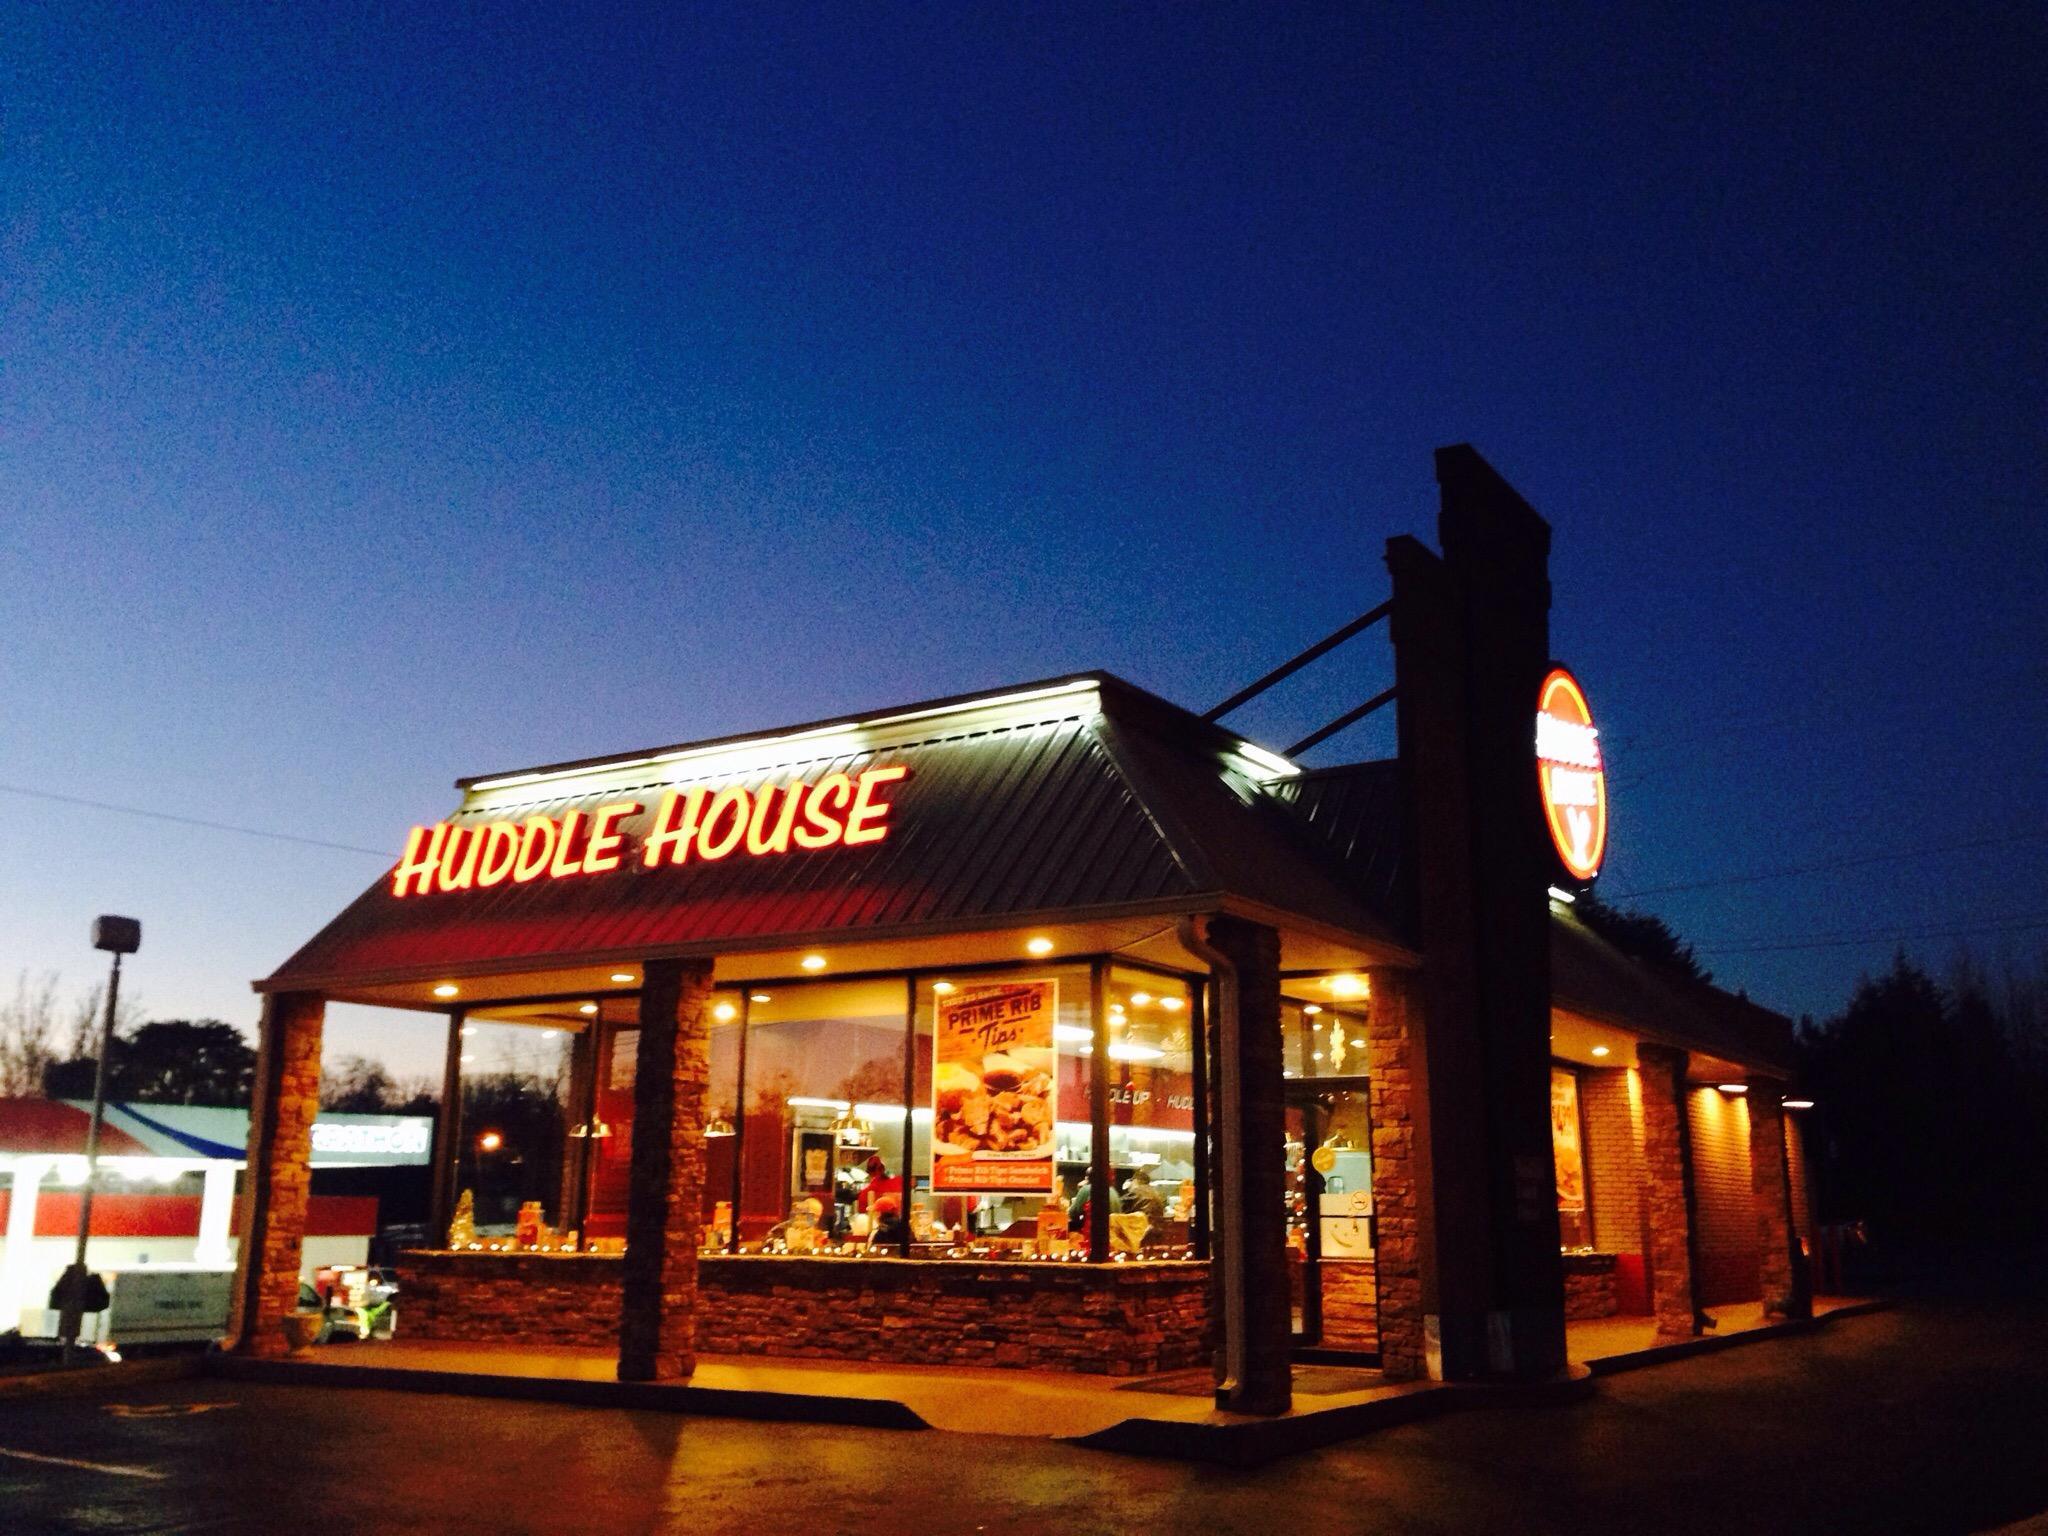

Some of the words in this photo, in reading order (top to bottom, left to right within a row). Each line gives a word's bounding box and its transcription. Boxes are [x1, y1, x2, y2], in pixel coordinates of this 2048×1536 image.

[393, 801, 643, 898] HUDDLE
[642, 765, 911, 869] HOUSE
[948, 1002, 1004, 1030] PRIME
[1010, 993, 1042, 1016] RIB
[1132, 1091, 1151, 1105] UP
